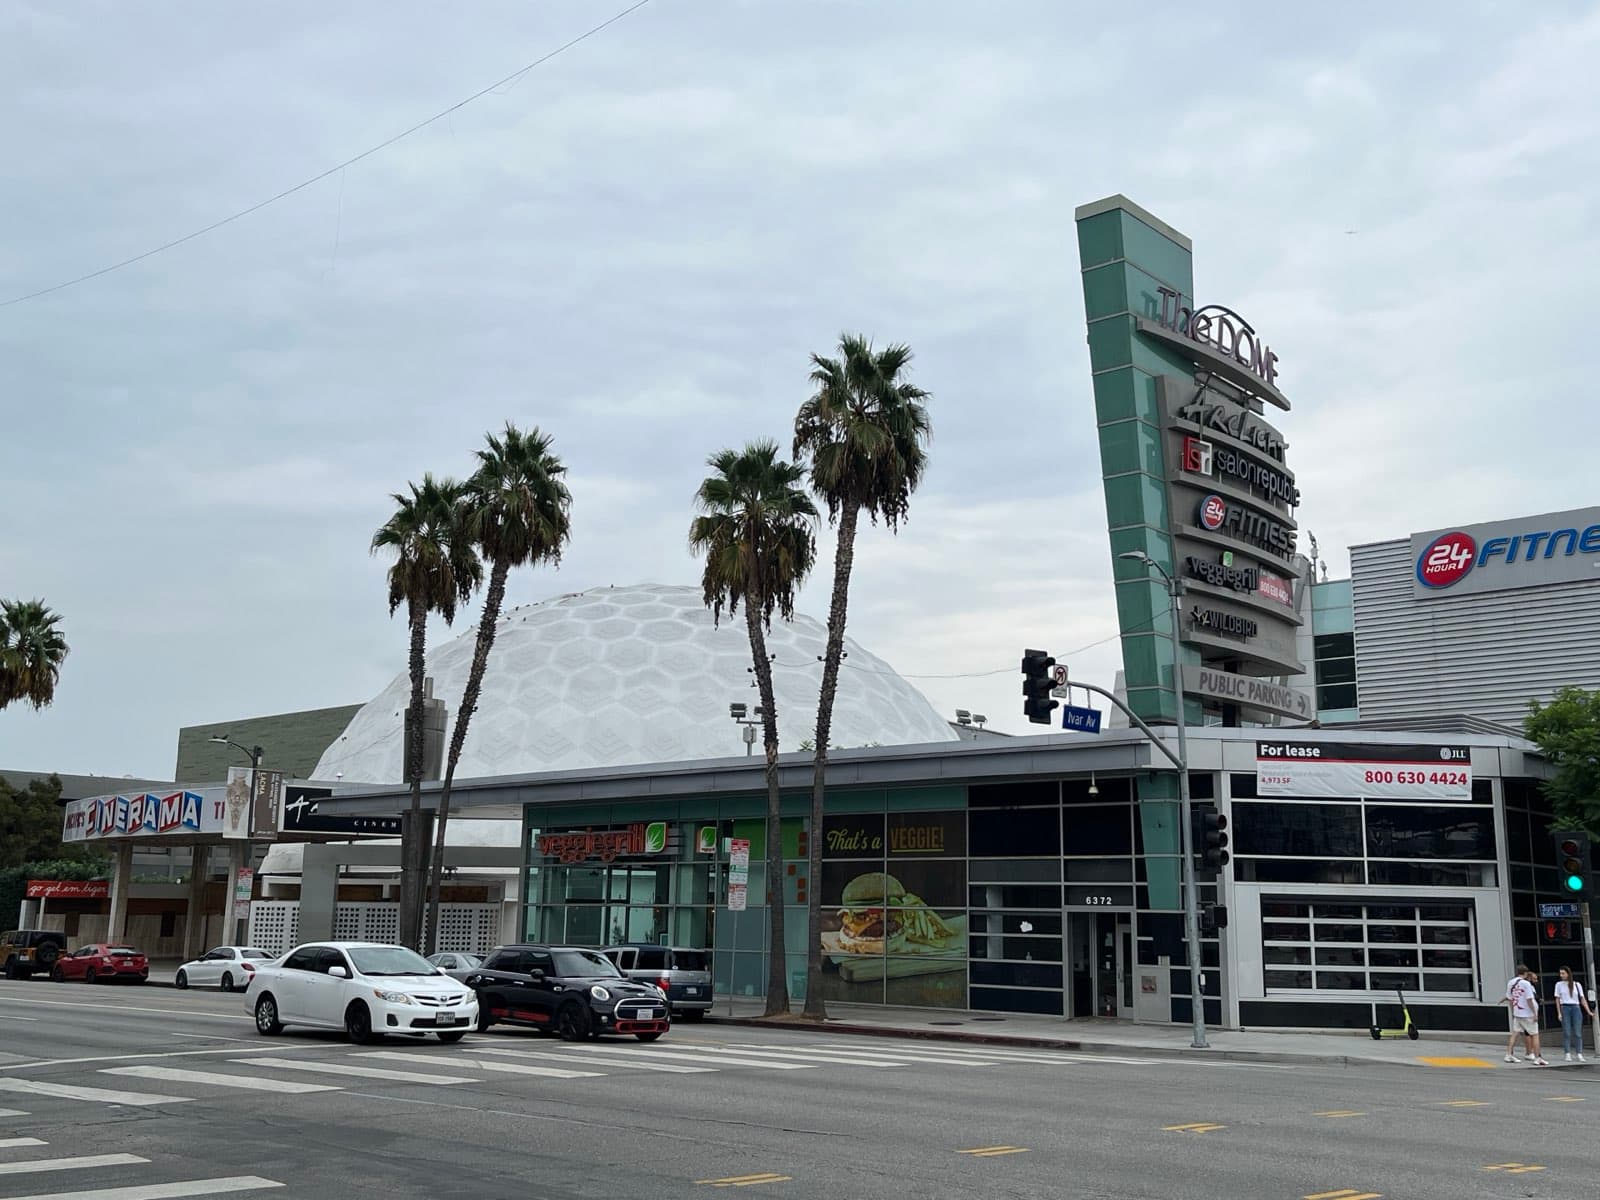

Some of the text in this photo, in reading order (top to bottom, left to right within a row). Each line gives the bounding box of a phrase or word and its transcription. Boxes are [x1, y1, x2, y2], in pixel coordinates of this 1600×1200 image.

[1157, 286, 1279, 388] The DOME
[1216, 450, 1301, 507] salonrepublic
[1206, 501, 1298, 550] 24 FITNESS
[1428, 542, 1473, 569] 24
[1425, 563, 1457, 574] HOUR
[1208, 610, 1258, 638] WILDBIRD
[1200, 671, 1293, 709] PUBLIC PARKING
[1067, 711, 1096, 728] Ivar Av
[1260, 743, 1321, 758] For lease
[1451, 749, 1467, 759] JLL
[1364, 770, 1468, 786] 800 630 4424
[85, 792, 201, 835] CINERAMA
[827, 826, 945, 851] That's a VEGGIE!
[1085, 896, 1113, 905] 6372
[1541, 903, 1563, 913] Sunset
